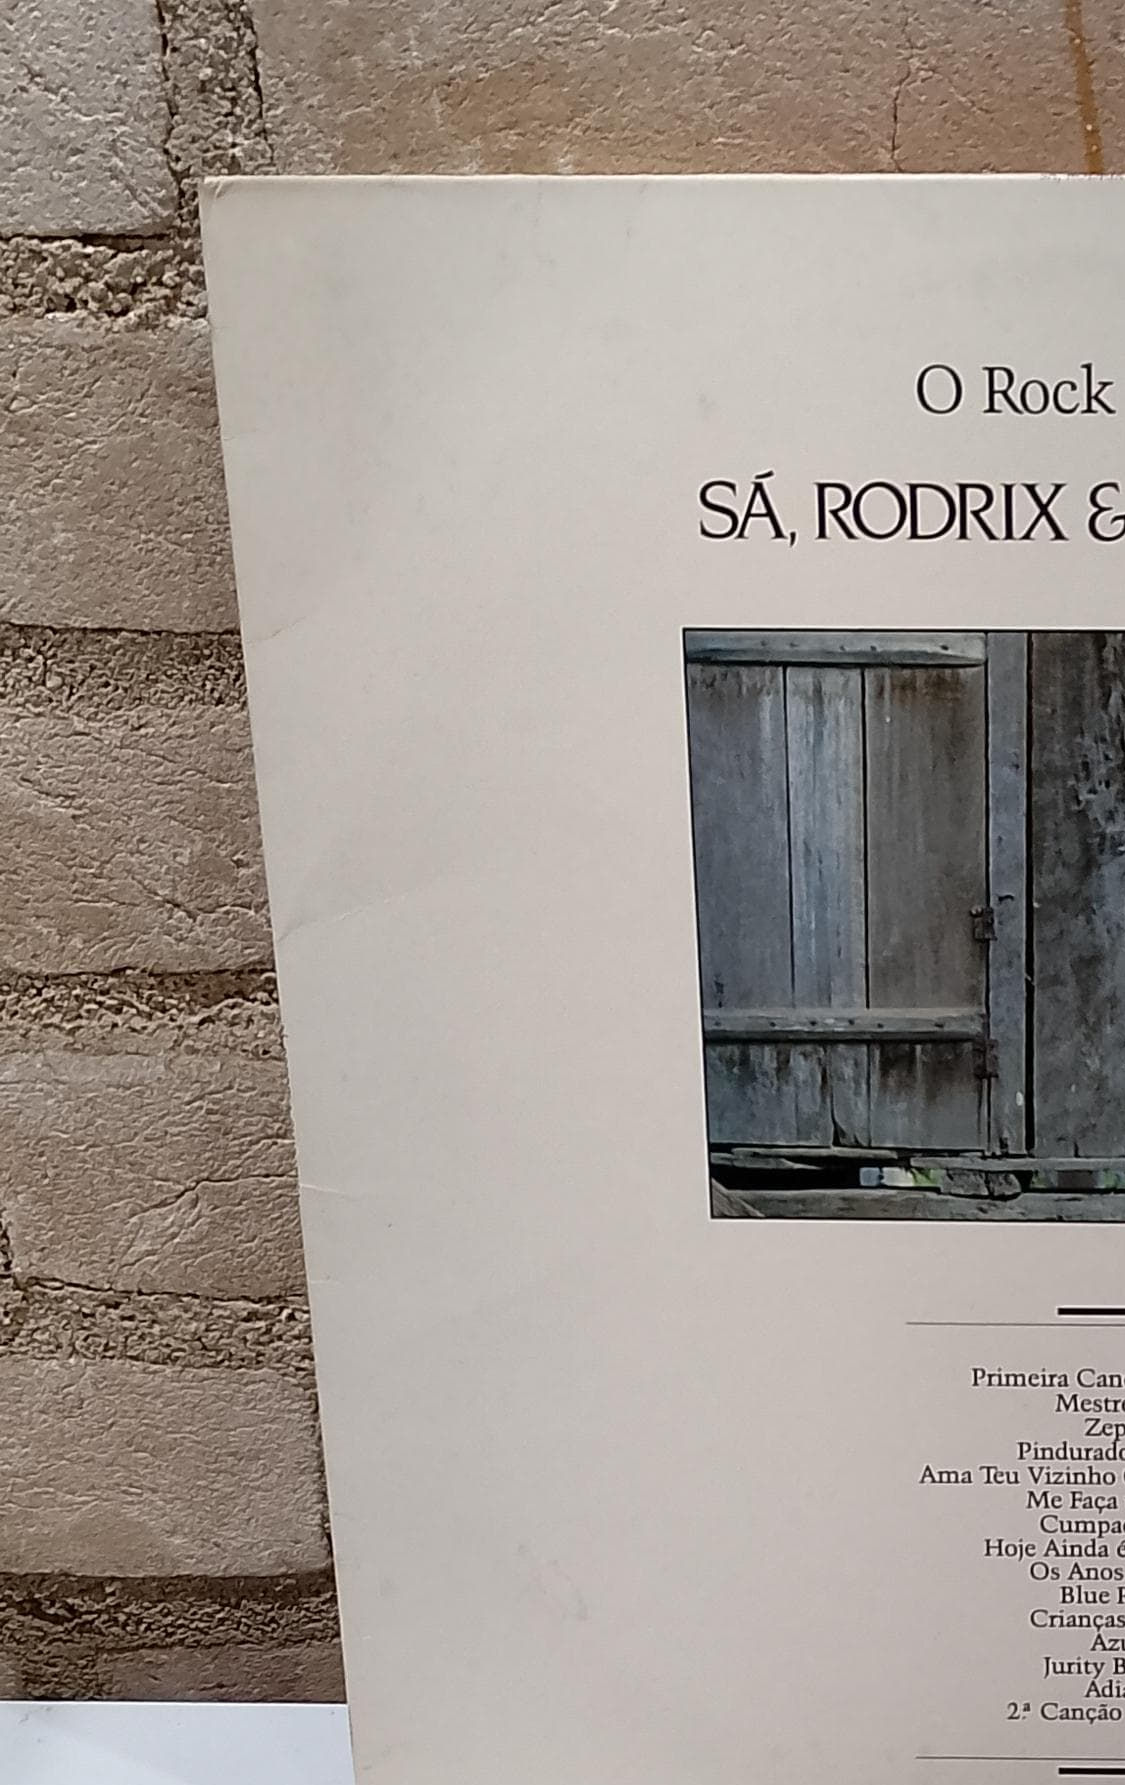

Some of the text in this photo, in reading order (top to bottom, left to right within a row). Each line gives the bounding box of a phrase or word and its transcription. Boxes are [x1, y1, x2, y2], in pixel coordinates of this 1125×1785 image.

[917, 365, 962, 414] O
[982, 363, 1116, 414] Rock
[700, 471, 796, 546] SÁ,
[815, 482, 1069, 541] RODRIX
[972, 1368, 1069, 1387] Primeira
[919, 1465, 972, 1484] Ama
[979, 1466, 1020, 1484] Teu
[1028, 1466, 1115, 1485] Vizinho
[1026, 1491, 1062, 1509] Me
[1070, 1491, 1118, 1514] Faça
[985, 1539, 1036, 1561] Hoje
[1043, 1538, 1109, 1557] Ainda
[1030, 1562, 1060, 1580] Os
[1067, 1562, 1124, 1581] Anos
[1060, 1585, 1110, 1604] Blue
[1031, 1609, 1125, 1631] Crianças
[1044, 1657, 1105, 1678] Jurity
[1041, 1703, 1122, 1724] Canção
